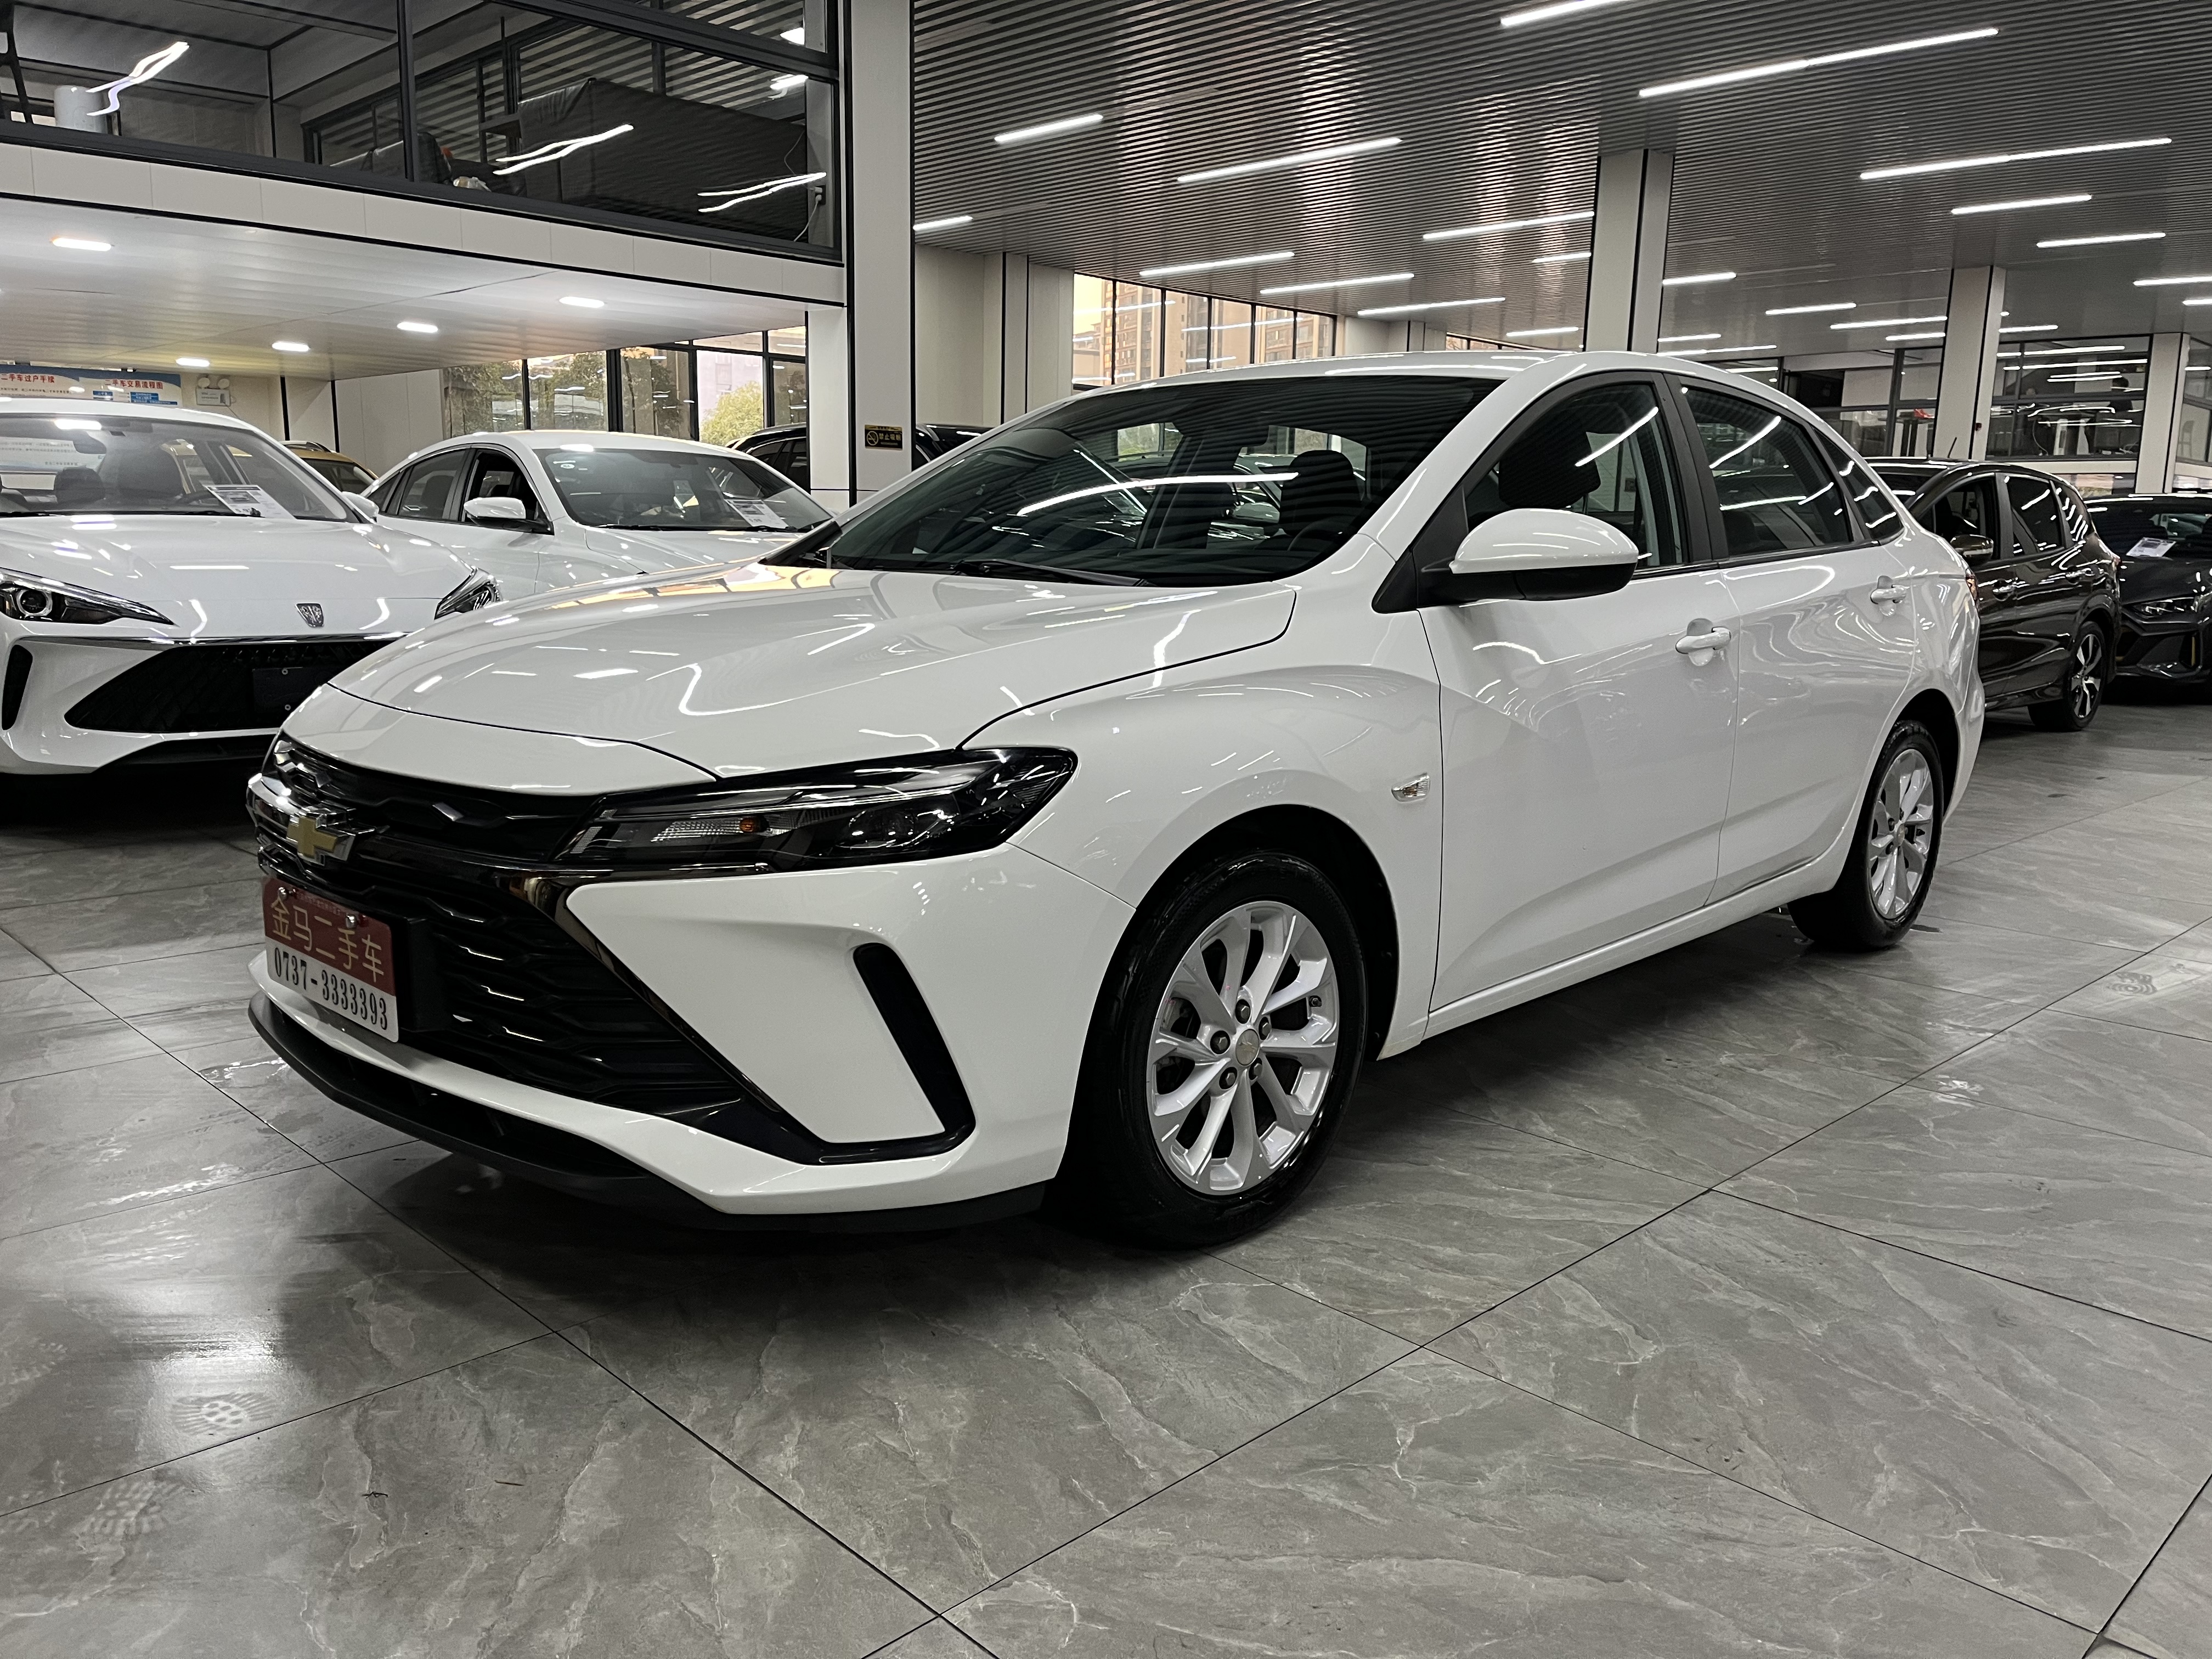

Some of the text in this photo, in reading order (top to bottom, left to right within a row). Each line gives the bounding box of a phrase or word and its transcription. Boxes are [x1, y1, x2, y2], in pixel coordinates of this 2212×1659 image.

[271, 897, 384, 983] 金马二手车
[274, 947, 387, 1030] 0737-3333393
